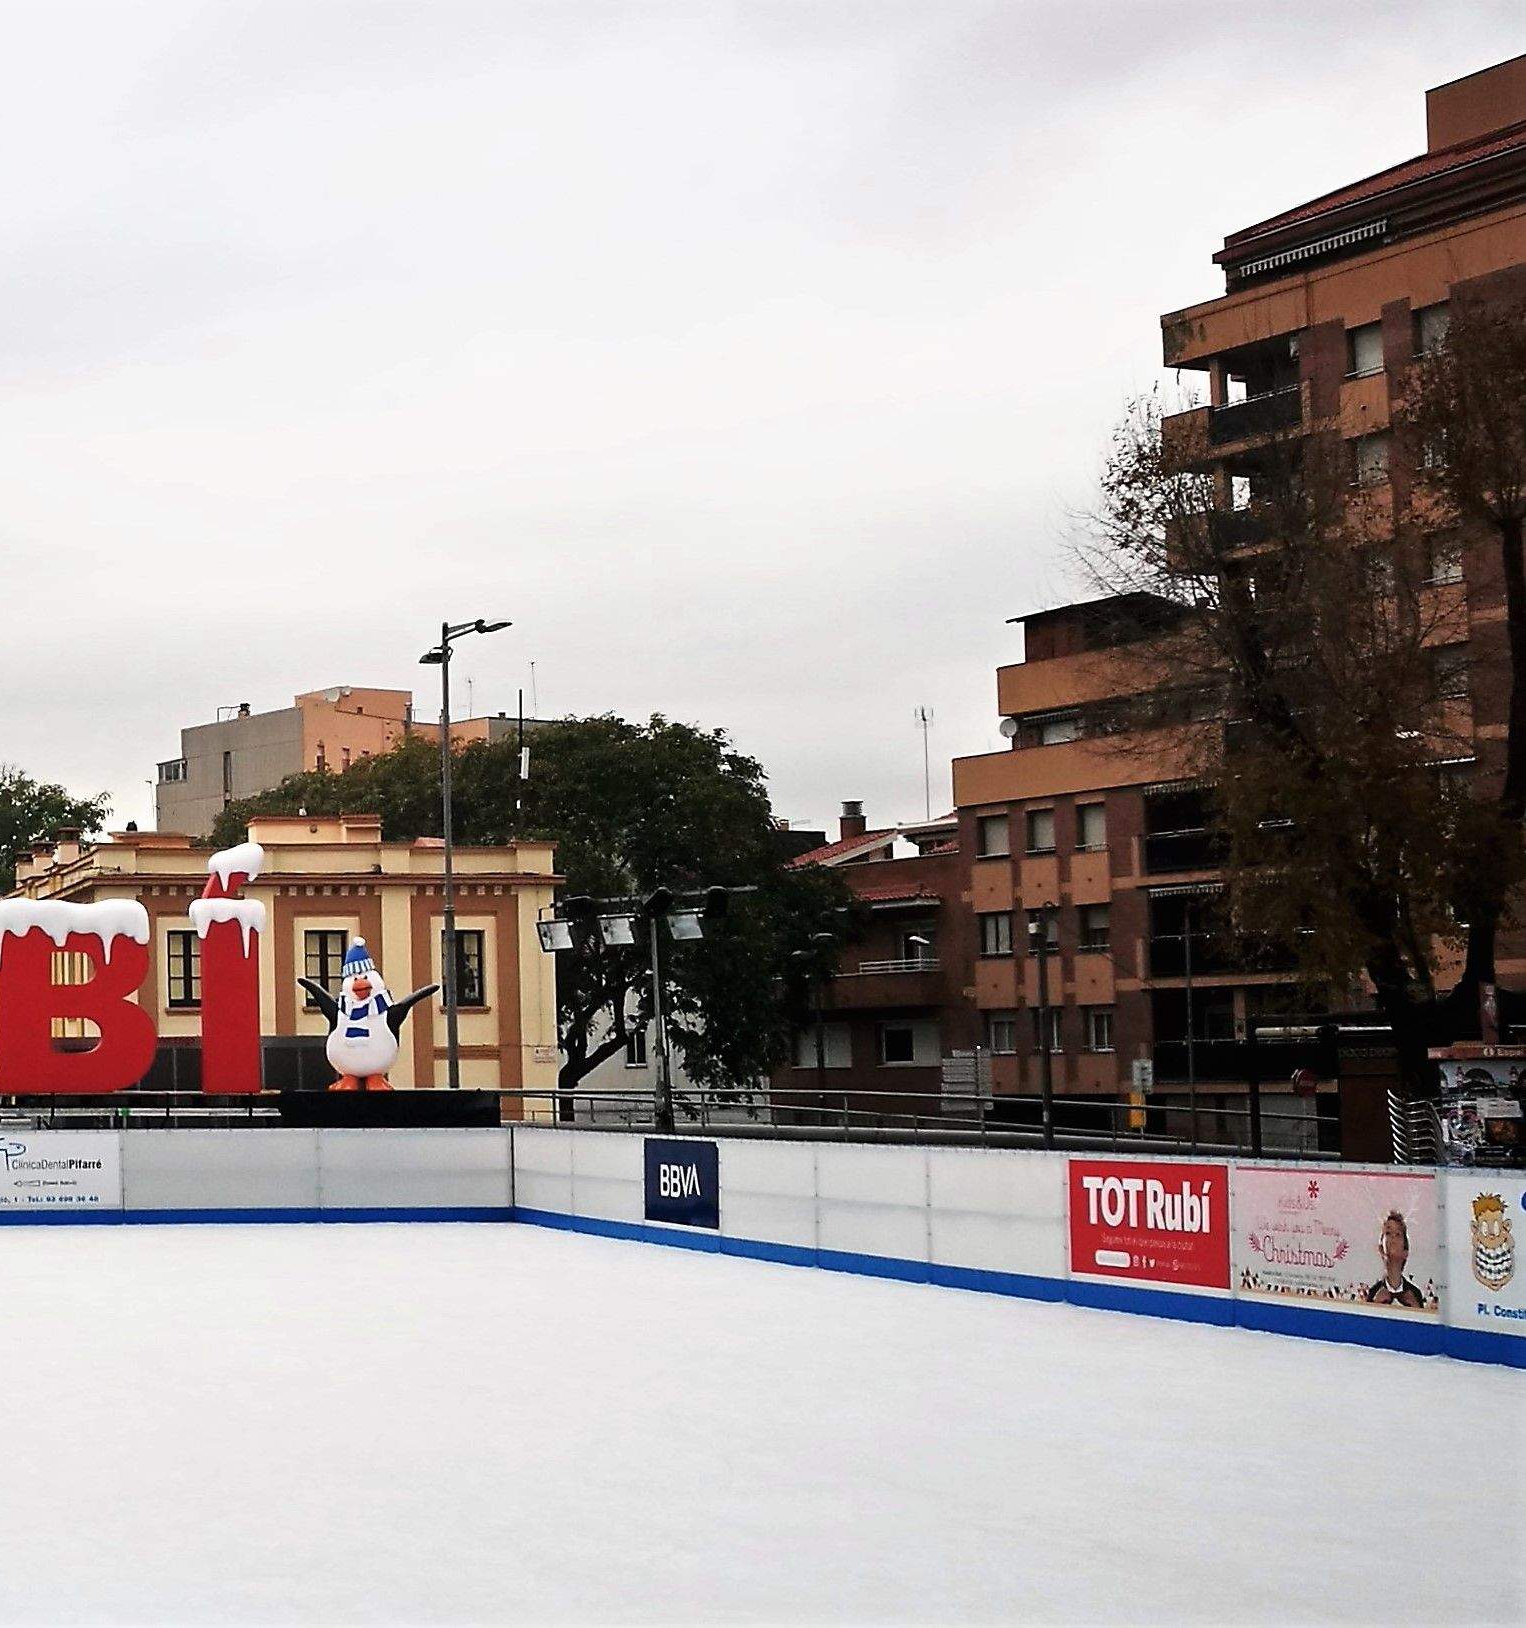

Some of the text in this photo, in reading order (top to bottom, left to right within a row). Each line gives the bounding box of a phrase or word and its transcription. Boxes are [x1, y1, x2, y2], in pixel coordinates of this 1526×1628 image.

[659, 1163, 702, 1198] BBVA
[1082, 1175, 1212, 1234] TOT Rubí
[1261, 1234, 1336, 1269] Christmas
